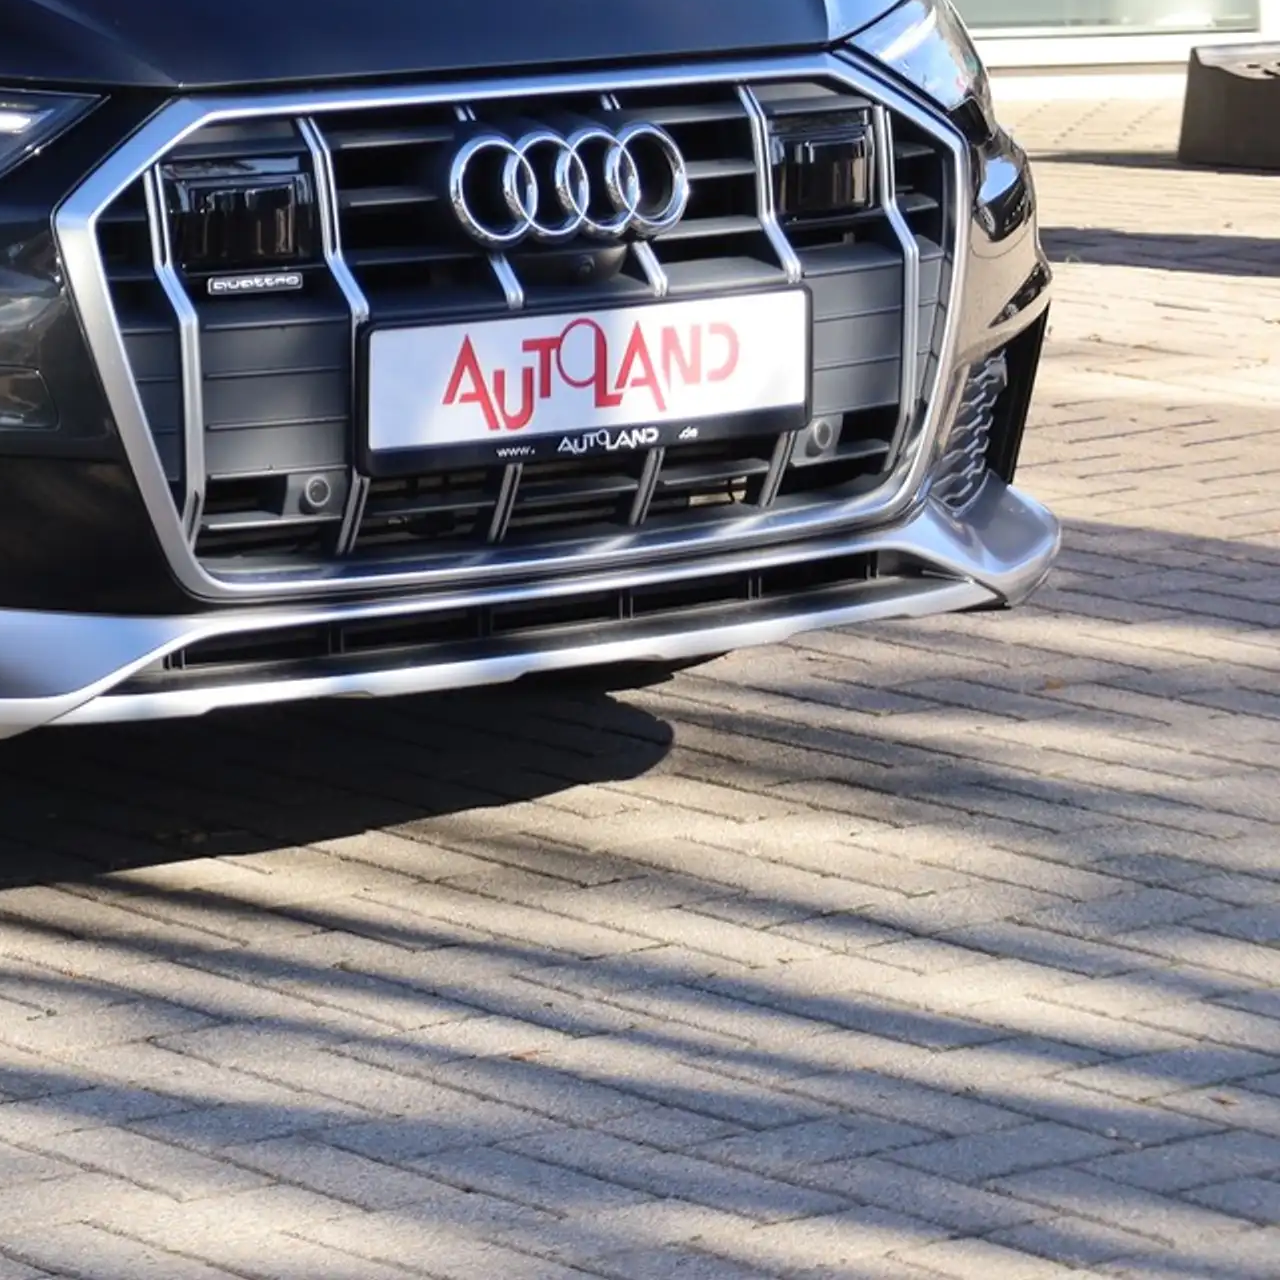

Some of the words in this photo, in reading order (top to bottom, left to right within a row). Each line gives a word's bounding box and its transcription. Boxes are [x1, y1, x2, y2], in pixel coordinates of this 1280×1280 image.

[212, 275, 300, 292] quattro
[442, 317, 740, 431] AUTOLAND
[557, 427, 660, 455] AUTOLAND
